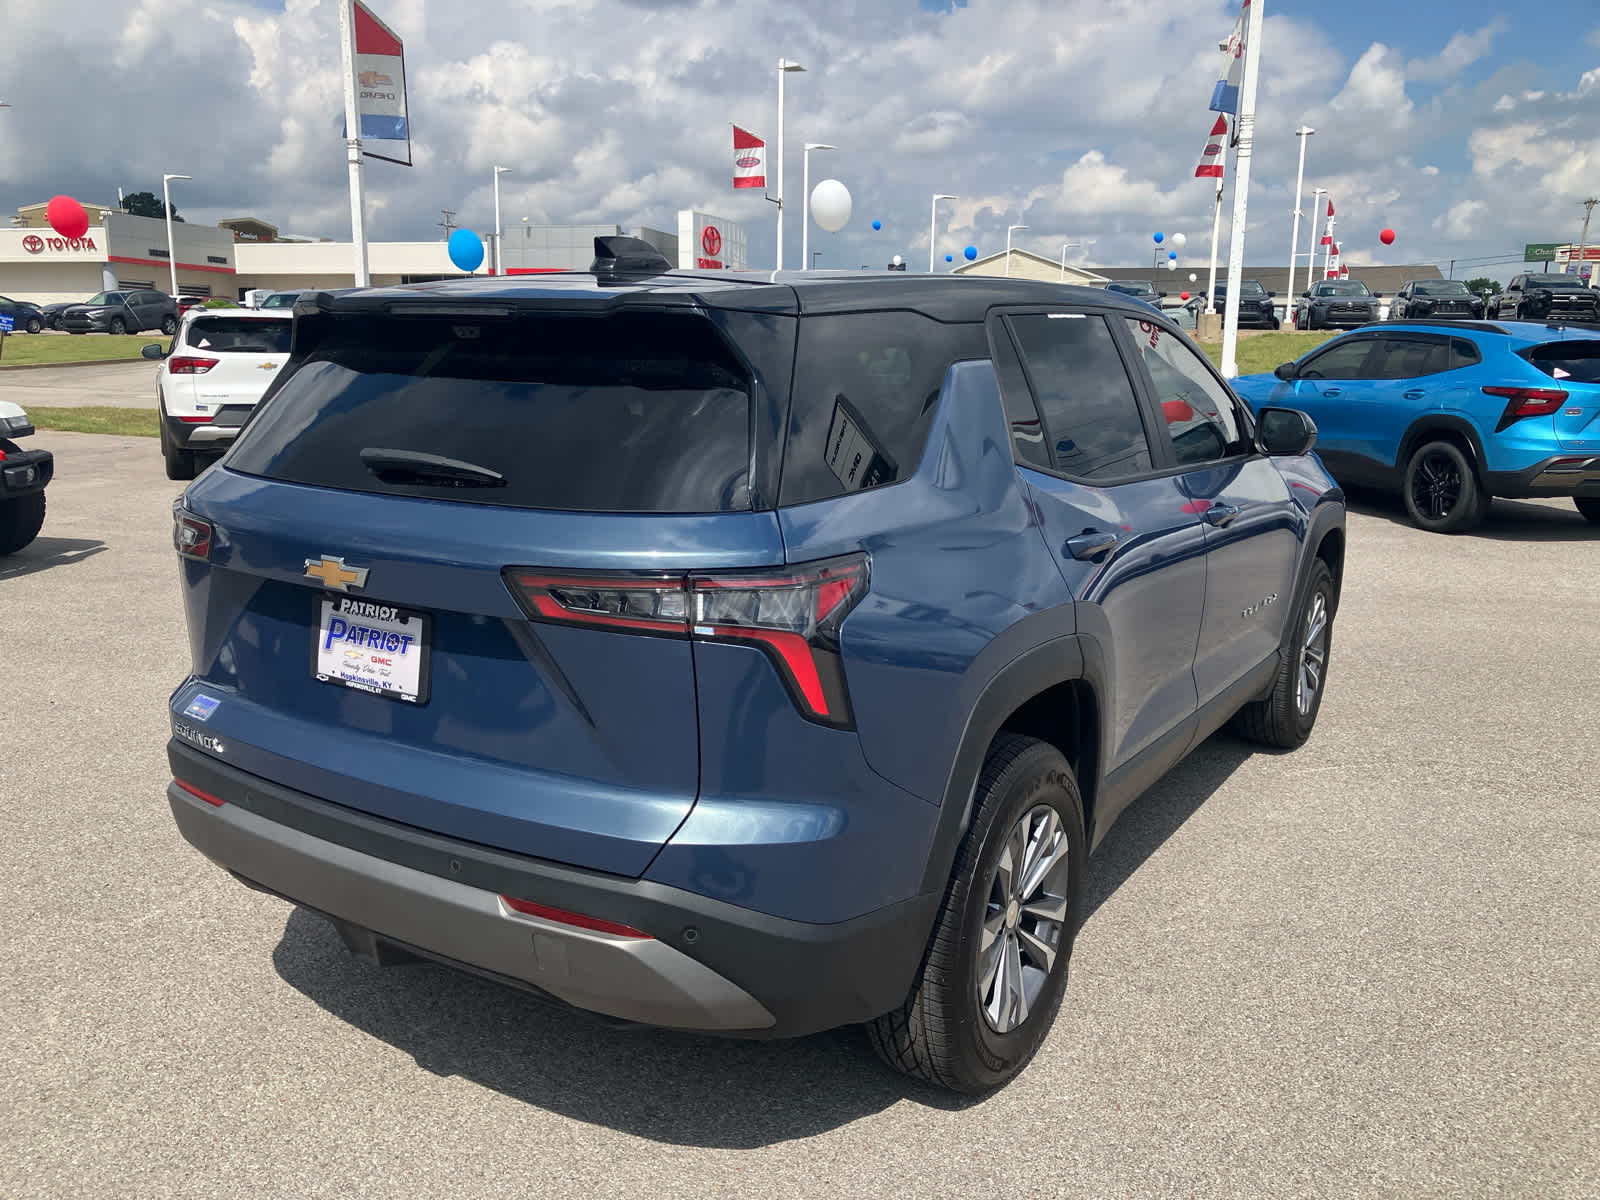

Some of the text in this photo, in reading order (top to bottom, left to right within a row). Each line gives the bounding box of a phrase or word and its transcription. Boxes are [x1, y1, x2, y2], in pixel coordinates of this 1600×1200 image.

[45, 237, 97, 251] TOYOTA
[340, 598, 398, 620] PATRIOT
[325, 617, 413, 655] PATRIOT
[371, 656, 392, 667] GMC
[382, 680, 393, 689] KY
